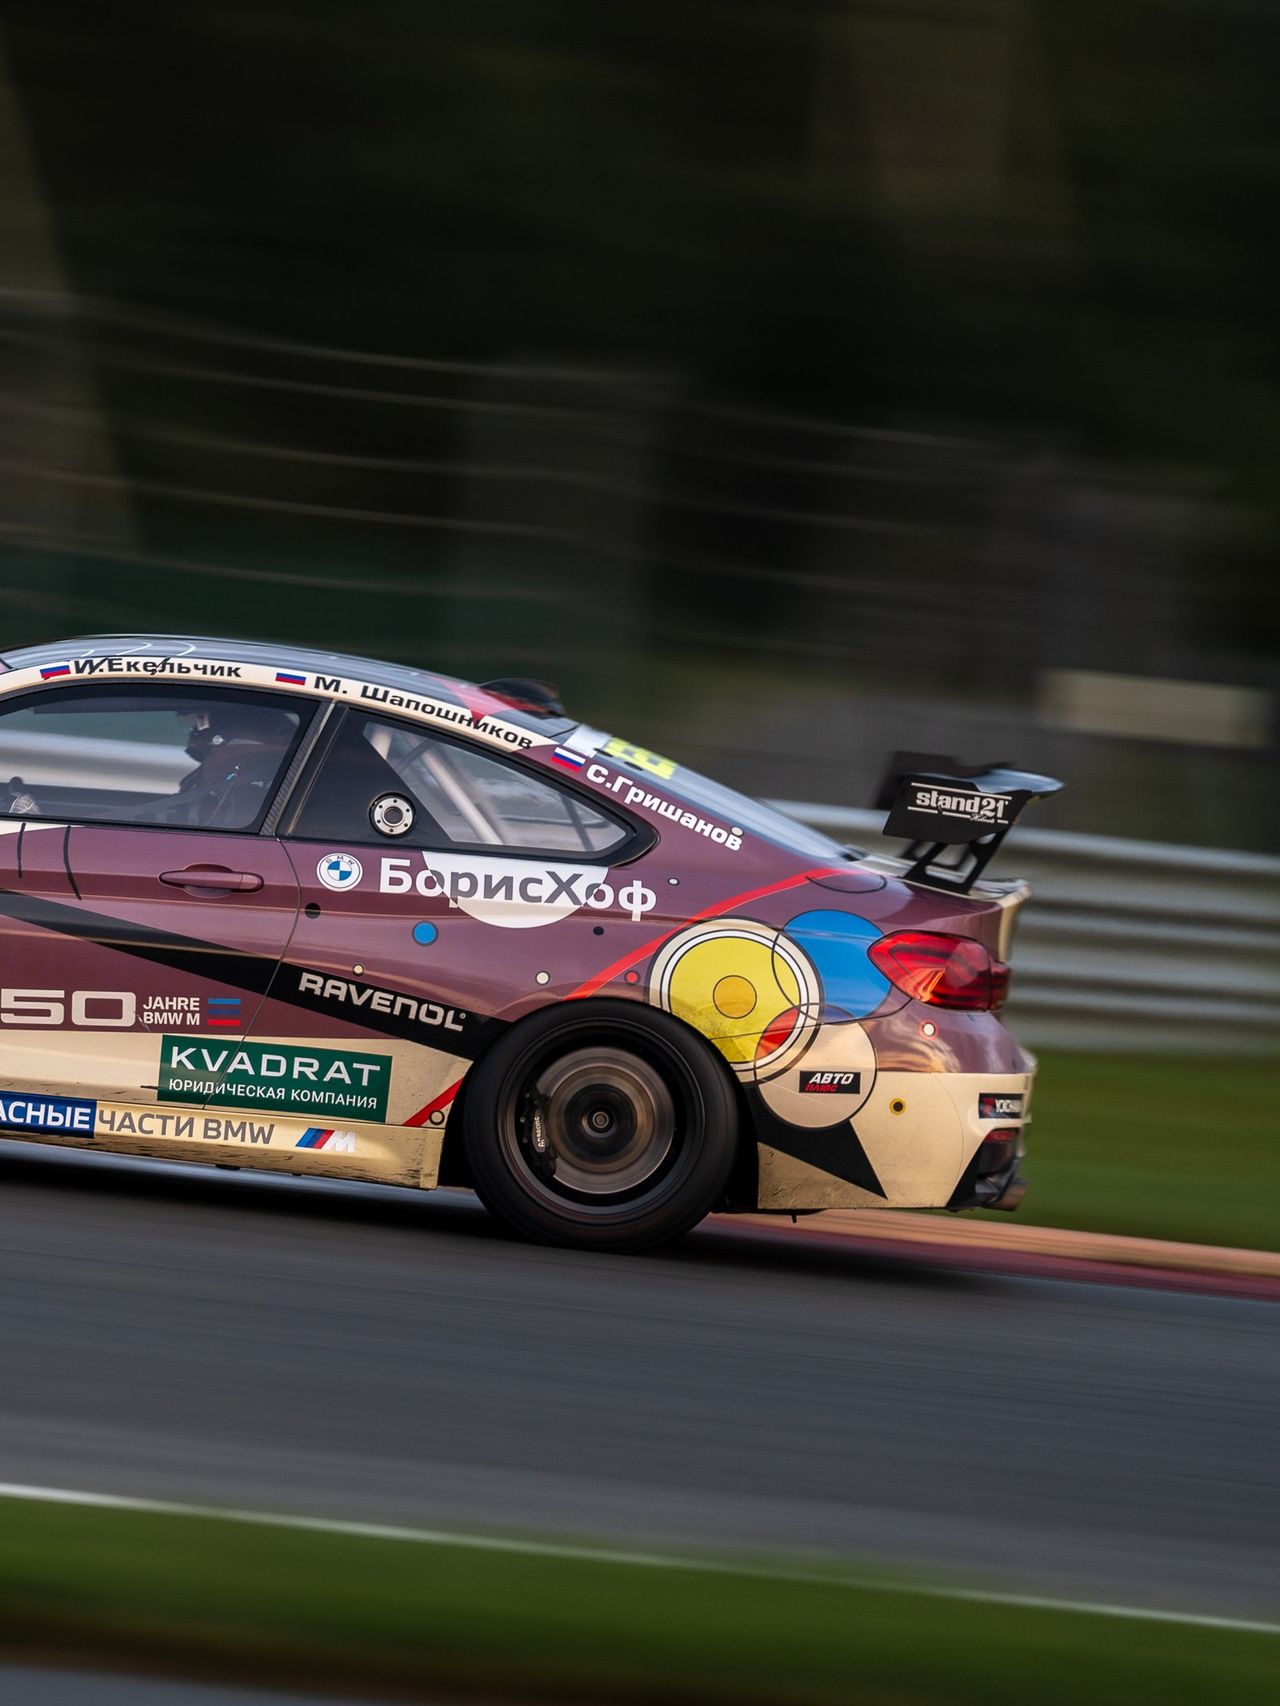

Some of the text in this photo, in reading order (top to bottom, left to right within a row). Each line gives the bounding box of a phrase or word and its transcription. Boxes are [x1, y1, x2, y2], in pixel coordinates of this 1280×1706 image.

[74, 657, 242, 678] И.Екельчик
[314, 676, 534, 749] М. Шапошников
[586, 764, 743, 851] С.Гришанов
[916, 790, 1007, 817] stand21
[379, 857, 658, 922] БорисХоф
[0, 988, 136, 1027] 50
[143, 996, 200, 1011] JAHRE
[143, 1011, 200, 1026] BMW M
[171, 1046, 381, 1087] KVADRAT
[809, 1073, 854, 1084] АВТО
[169, 1078, 378, 1109] ЮРИДИЧЕСКАЯ КОМПАНИЯ
[805, 1084, 838, 1092] ПЛЮС
[98, 1109, 194, 1139] ЧАСТИ
[203, 1118, 275, 1144] BMW
